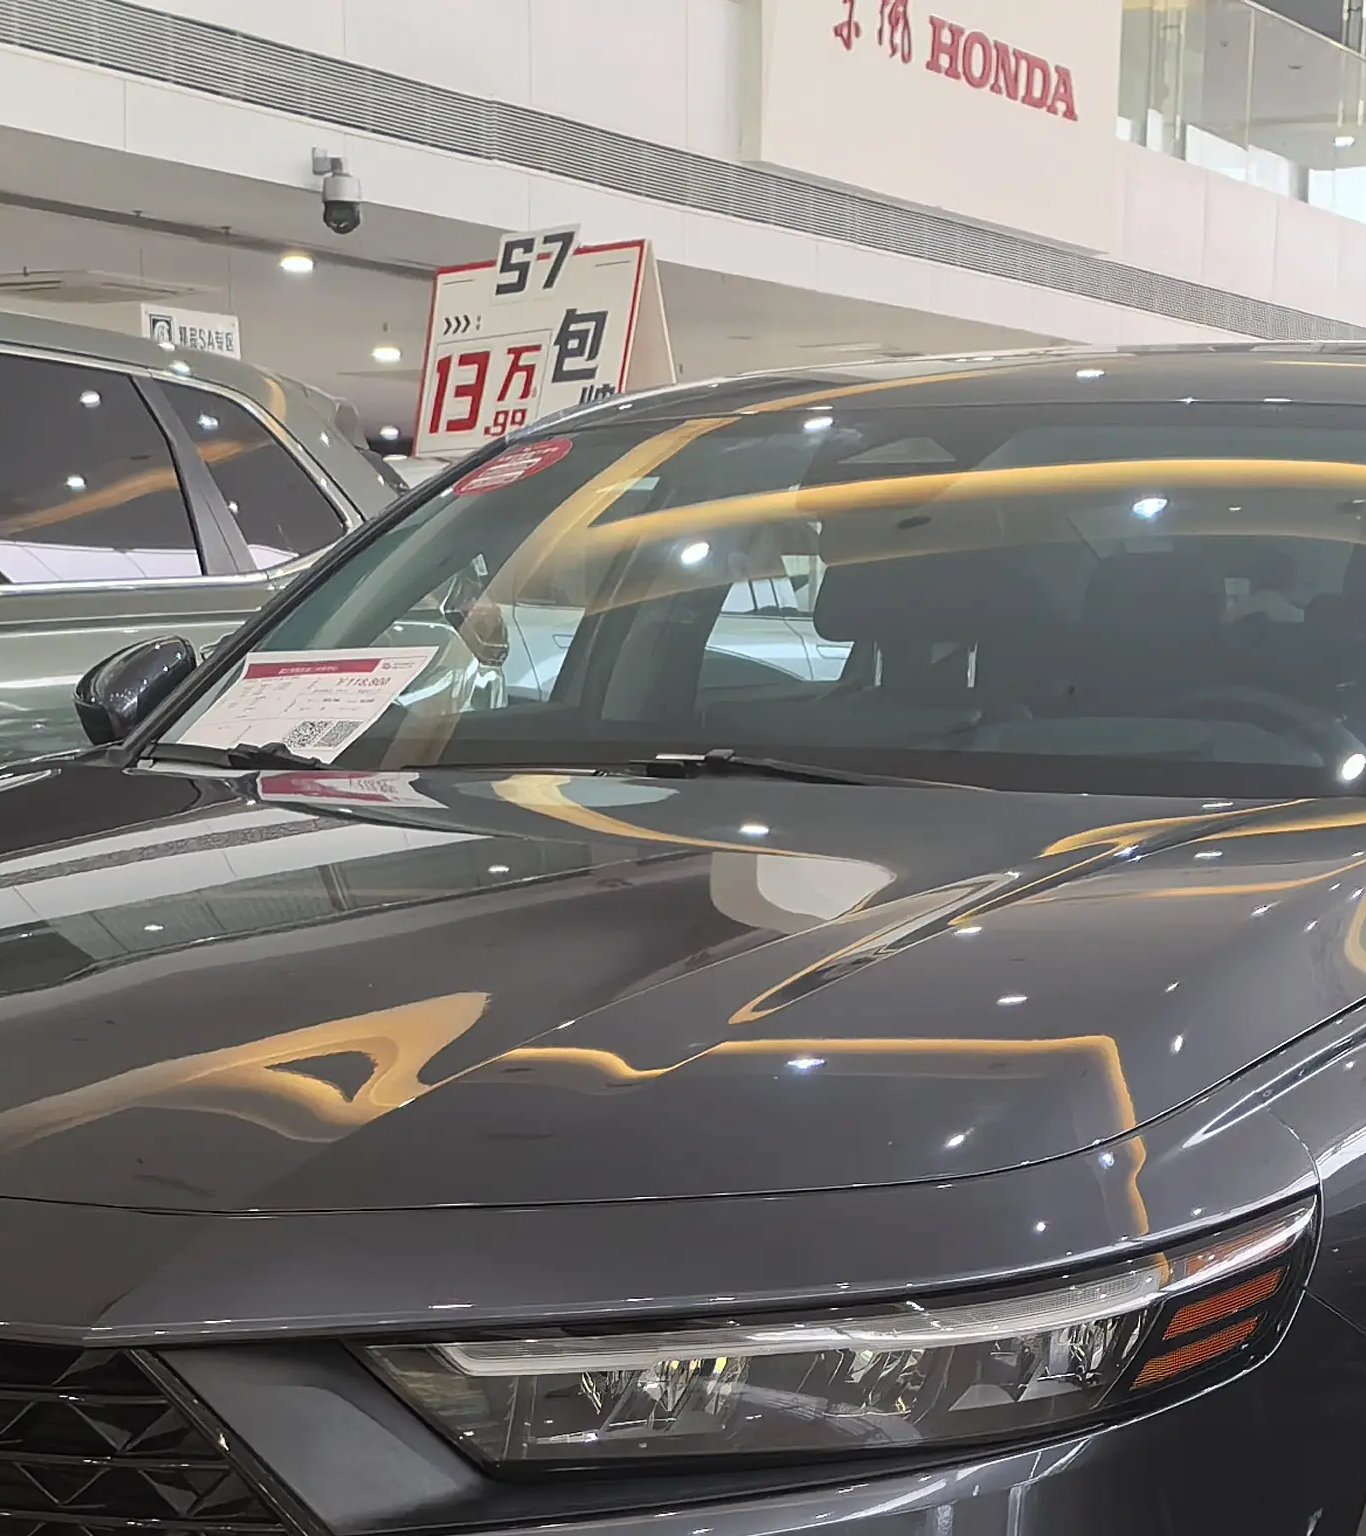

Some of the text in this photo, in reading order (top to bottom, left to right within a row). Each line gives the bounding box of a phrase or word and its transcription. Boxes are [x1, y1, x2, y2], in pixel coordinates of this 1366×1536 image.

[926, 15, 1078, 121] HONDA
[495, 231, 575, 296] S7
[429, 351, 491, 434] 13
